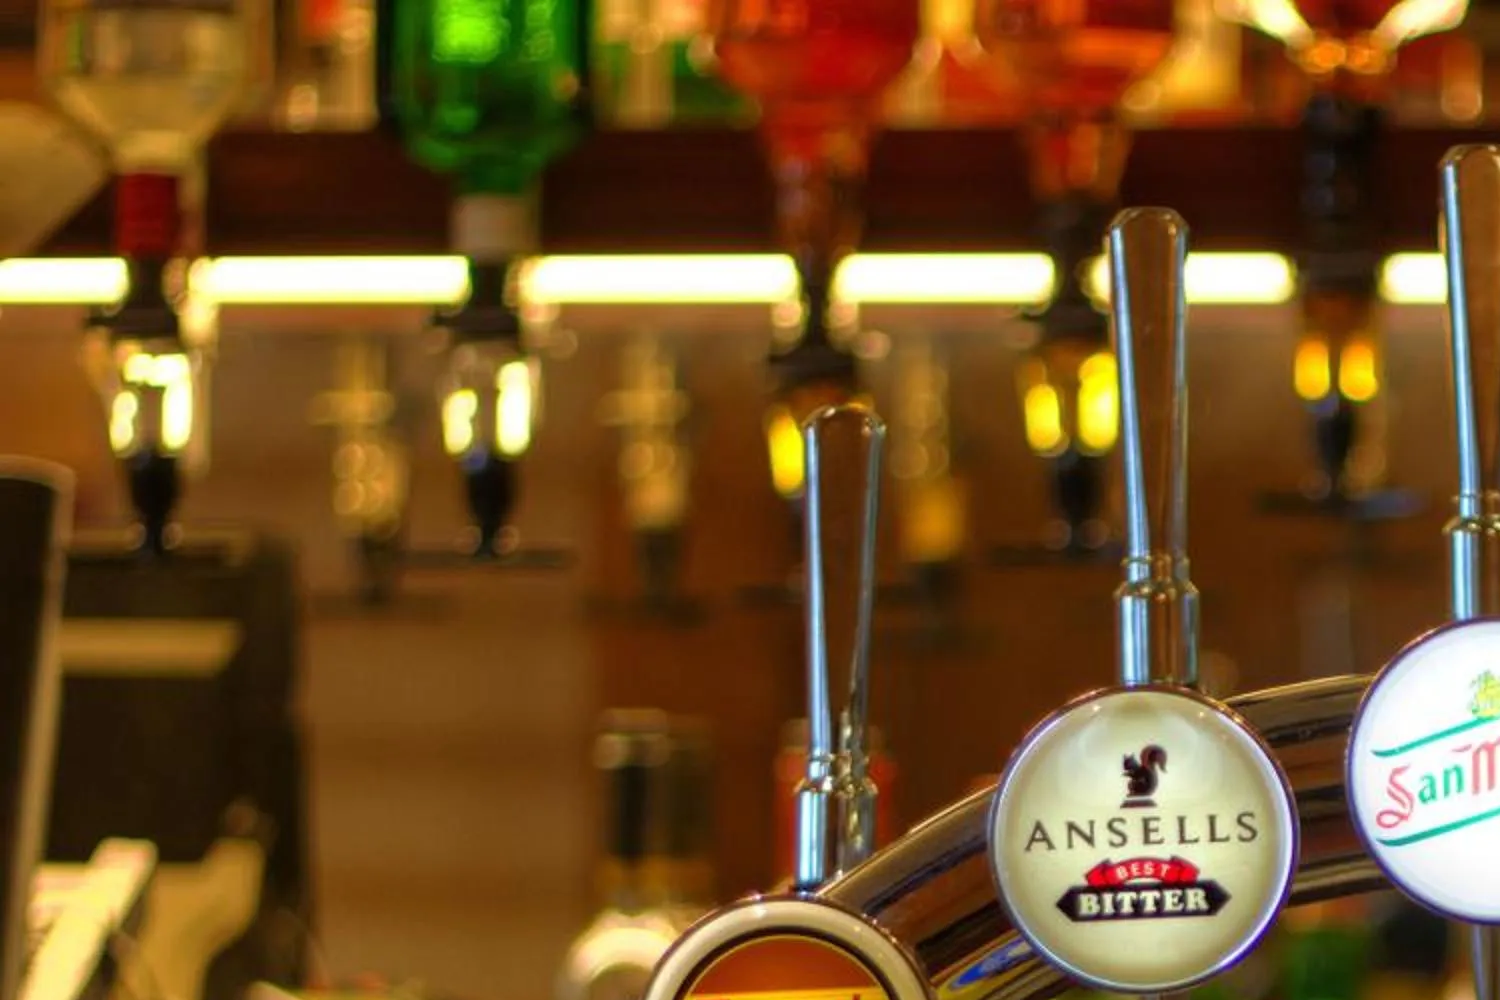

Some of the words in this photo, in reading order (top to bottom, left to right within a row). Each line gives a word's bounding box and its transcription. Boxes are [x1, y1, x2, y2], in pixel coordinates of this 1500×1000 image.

[1024, 811, 1259, 851] ANSELLS
[1114, 862, 1171, 880] BEST
[1079, 887, 1210, 917] BITTER
